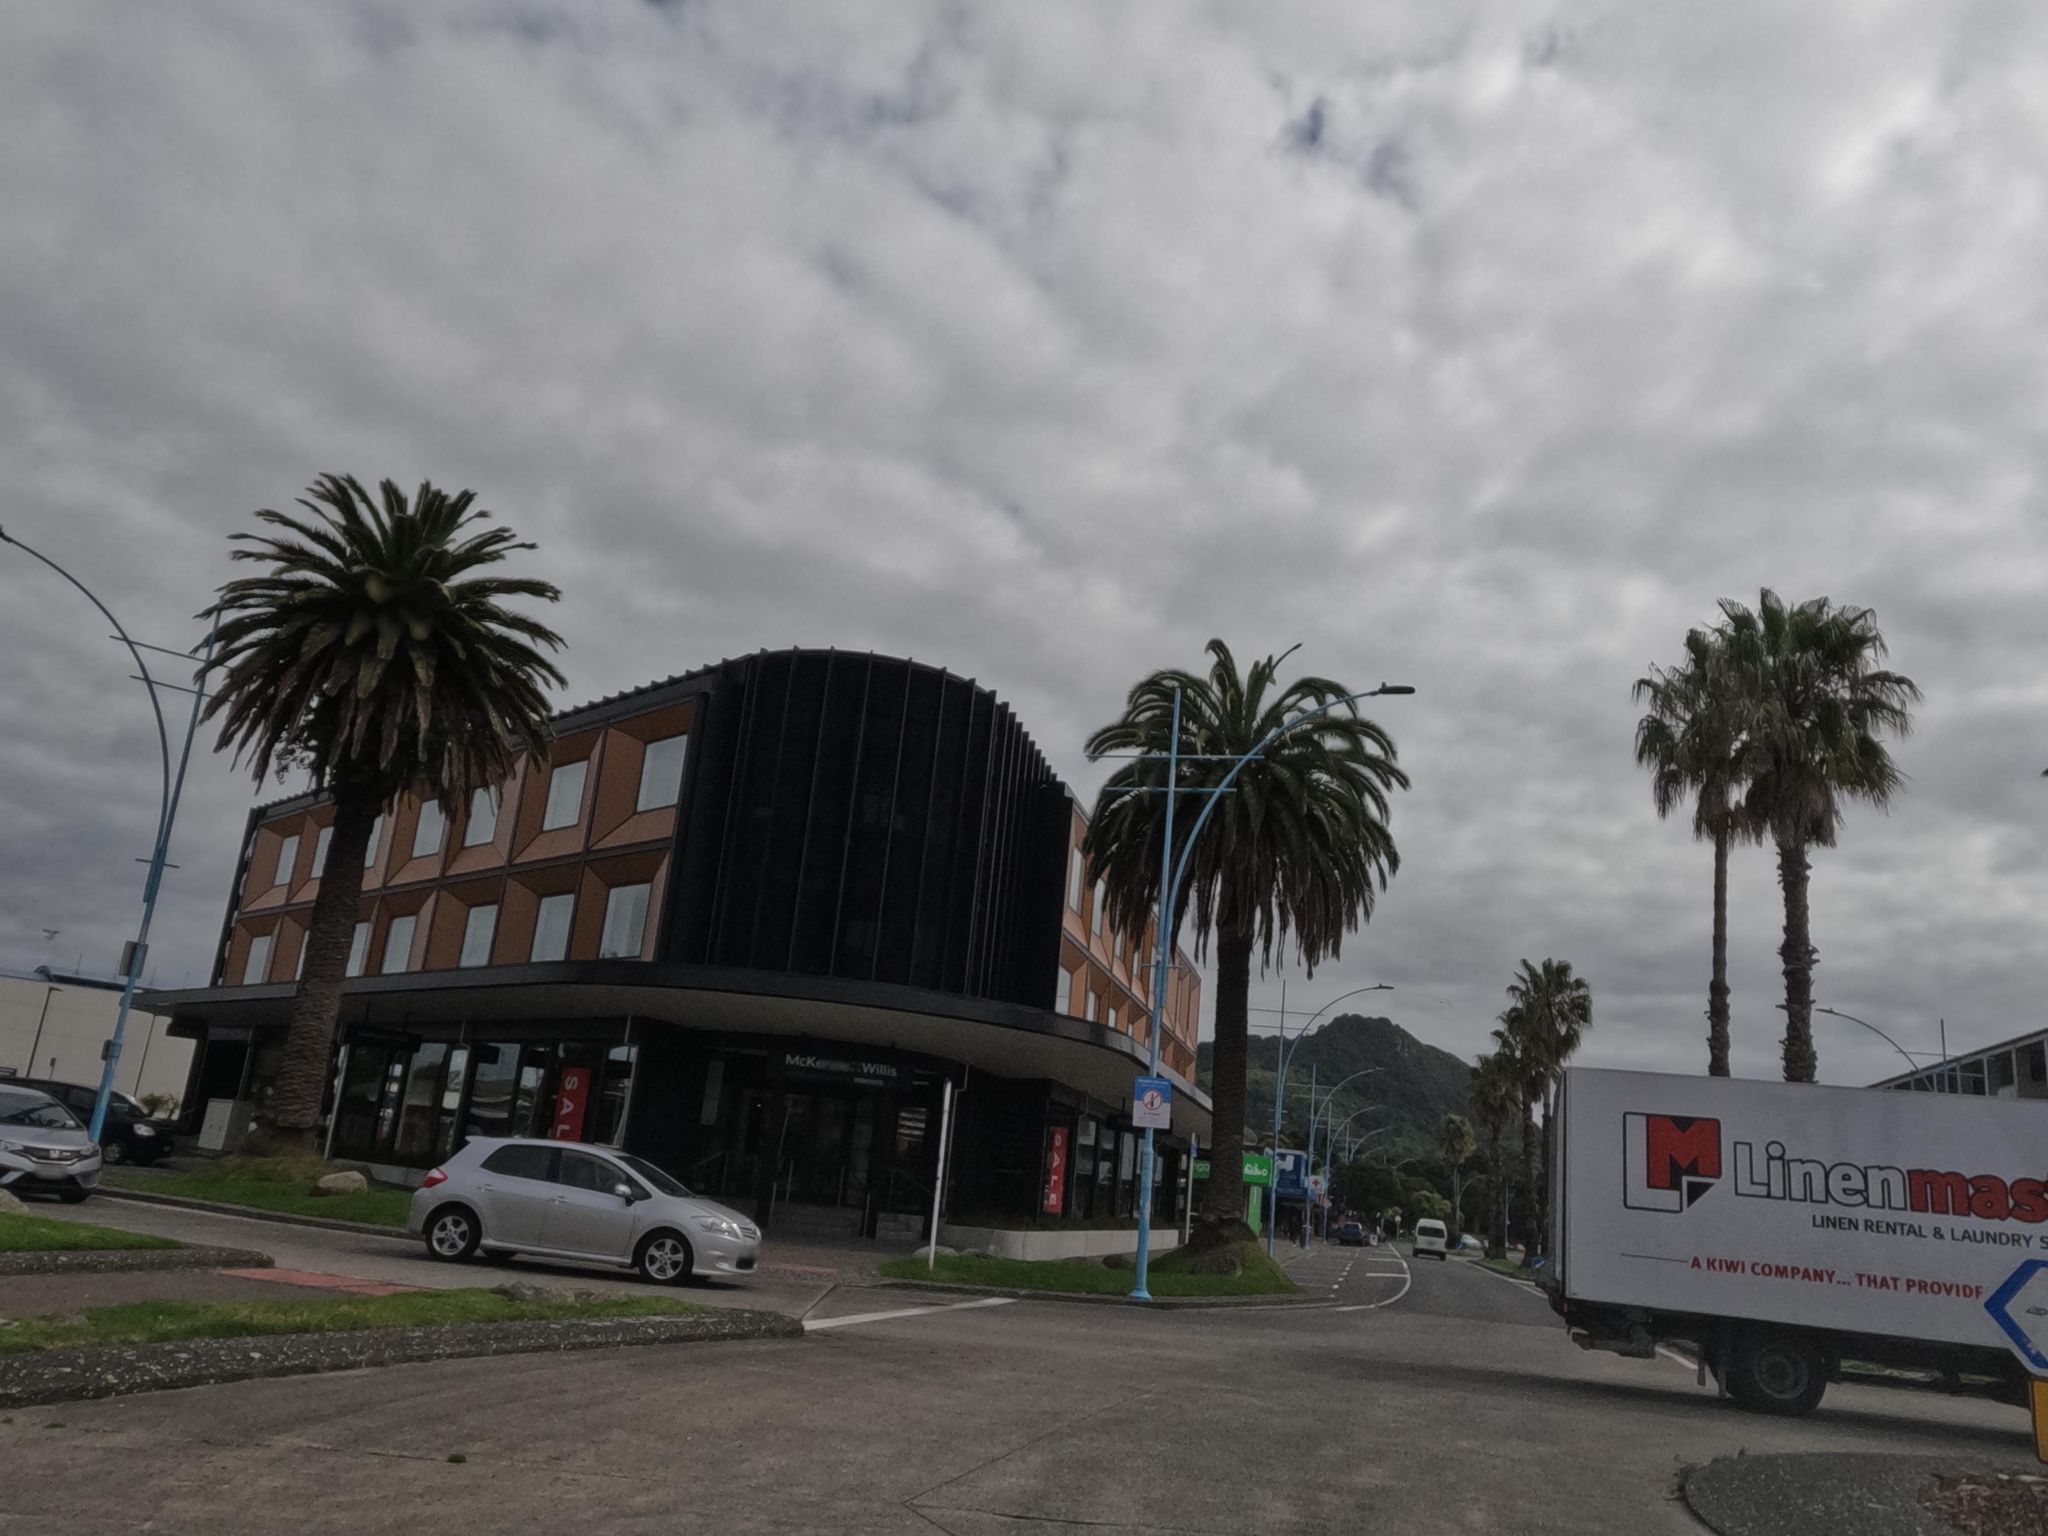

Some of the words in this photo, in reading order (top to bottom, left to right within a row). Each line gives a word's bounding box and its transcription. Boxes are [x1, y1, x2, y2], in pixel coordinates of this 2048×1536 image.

[862, 1063, 897, 1077] Willis
[556, 1075, 579, 1139] SAL
[1734, 1141, 2048, 1223] Linenmas
[1812, 1214, 1860, 1231] LINEN
[1864, 1219, 1927, 1239] RENTAL
[1932, 1226, 1945, 1240] &
[1951, 1228, 2033, 1248] LAUNDRY
[1691, 1256, 1701, 1270] A
[1707, 1258, 1745, 1274] KIWI
[1751, 1262, 1852, 1287] COMPANY...
[1856, 1273, 1900, 1292] THAT
